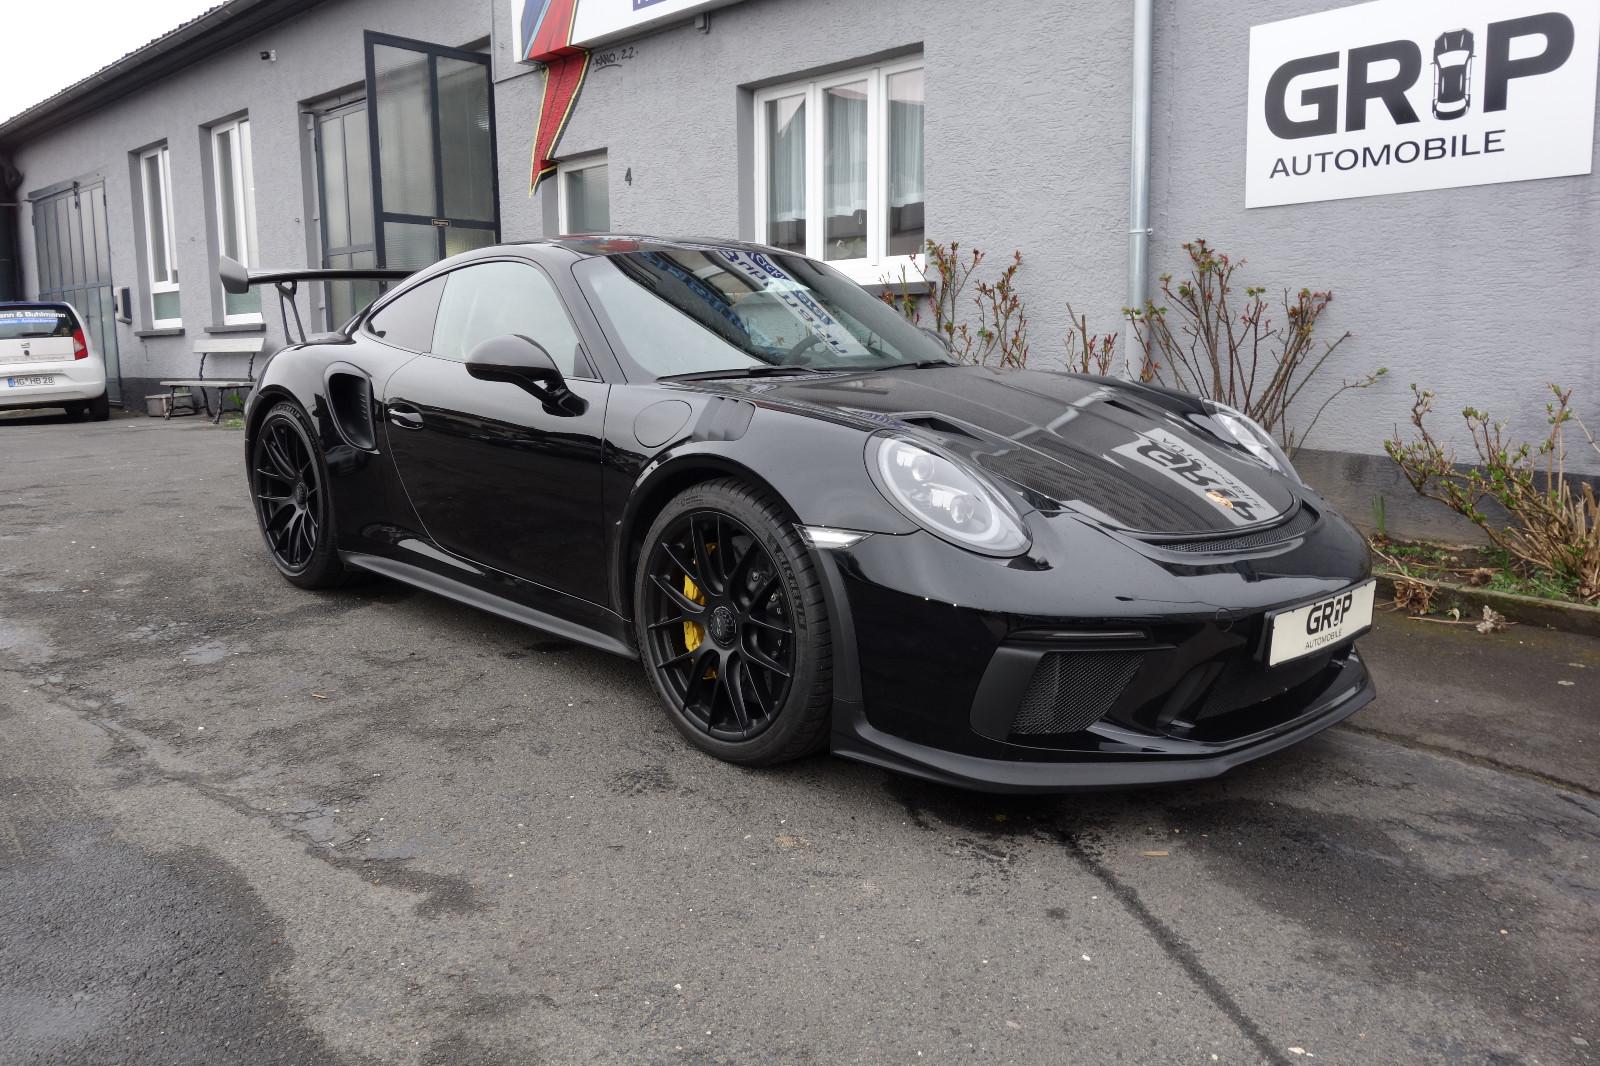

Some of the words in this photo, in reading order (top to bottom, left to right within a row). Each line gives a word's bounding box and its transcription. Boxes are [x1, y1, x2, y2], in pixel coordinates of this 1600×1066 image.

[1264, 12, 1575, 140] GRIP
[1269, 129, 1506, 180] AUTOMOBILE
[624, 167, 633, 187] 4
[43, 376, 54, 384] 28
[1306, 594, 1353, 635] GRIP
[1305, 630, 1342, 649] AUTOMOBILE
